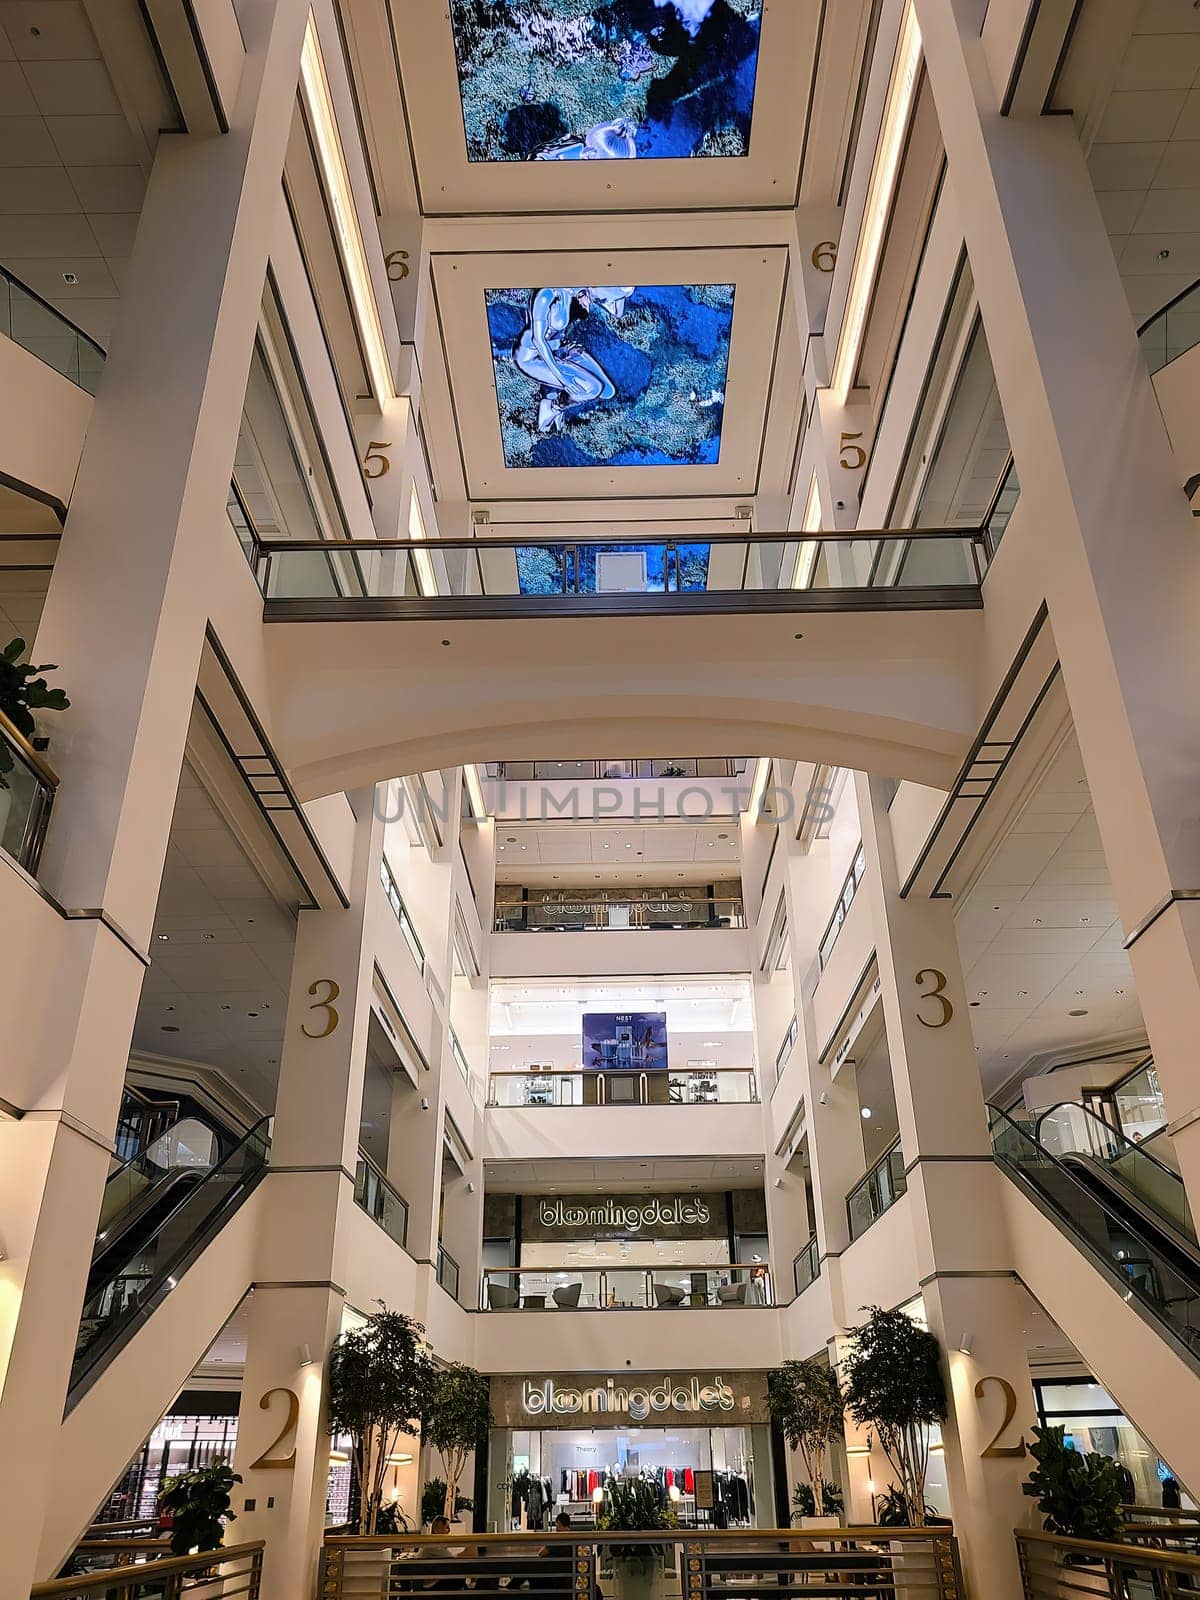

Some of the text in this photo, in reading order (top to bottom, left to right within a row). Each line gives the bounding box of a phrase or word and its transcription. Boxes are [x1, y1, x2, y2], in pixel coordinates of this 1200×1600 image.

[384, 250, 410, 282] 6
[811, 241, 837, 273] 6
[363, 440, 392, 479] 5
[839, 432, 867, 470] 5
[300, 979, 340, 1040] 3
[915, 968, 954, 1028] 3
[539, 1197, 710, 1232] bloomingdale's
[521, 1375, 735, 1421] bloomingdale's
[974, 1376, 1027, 1458] 2
[250, 1388, 300, 1470] 2
